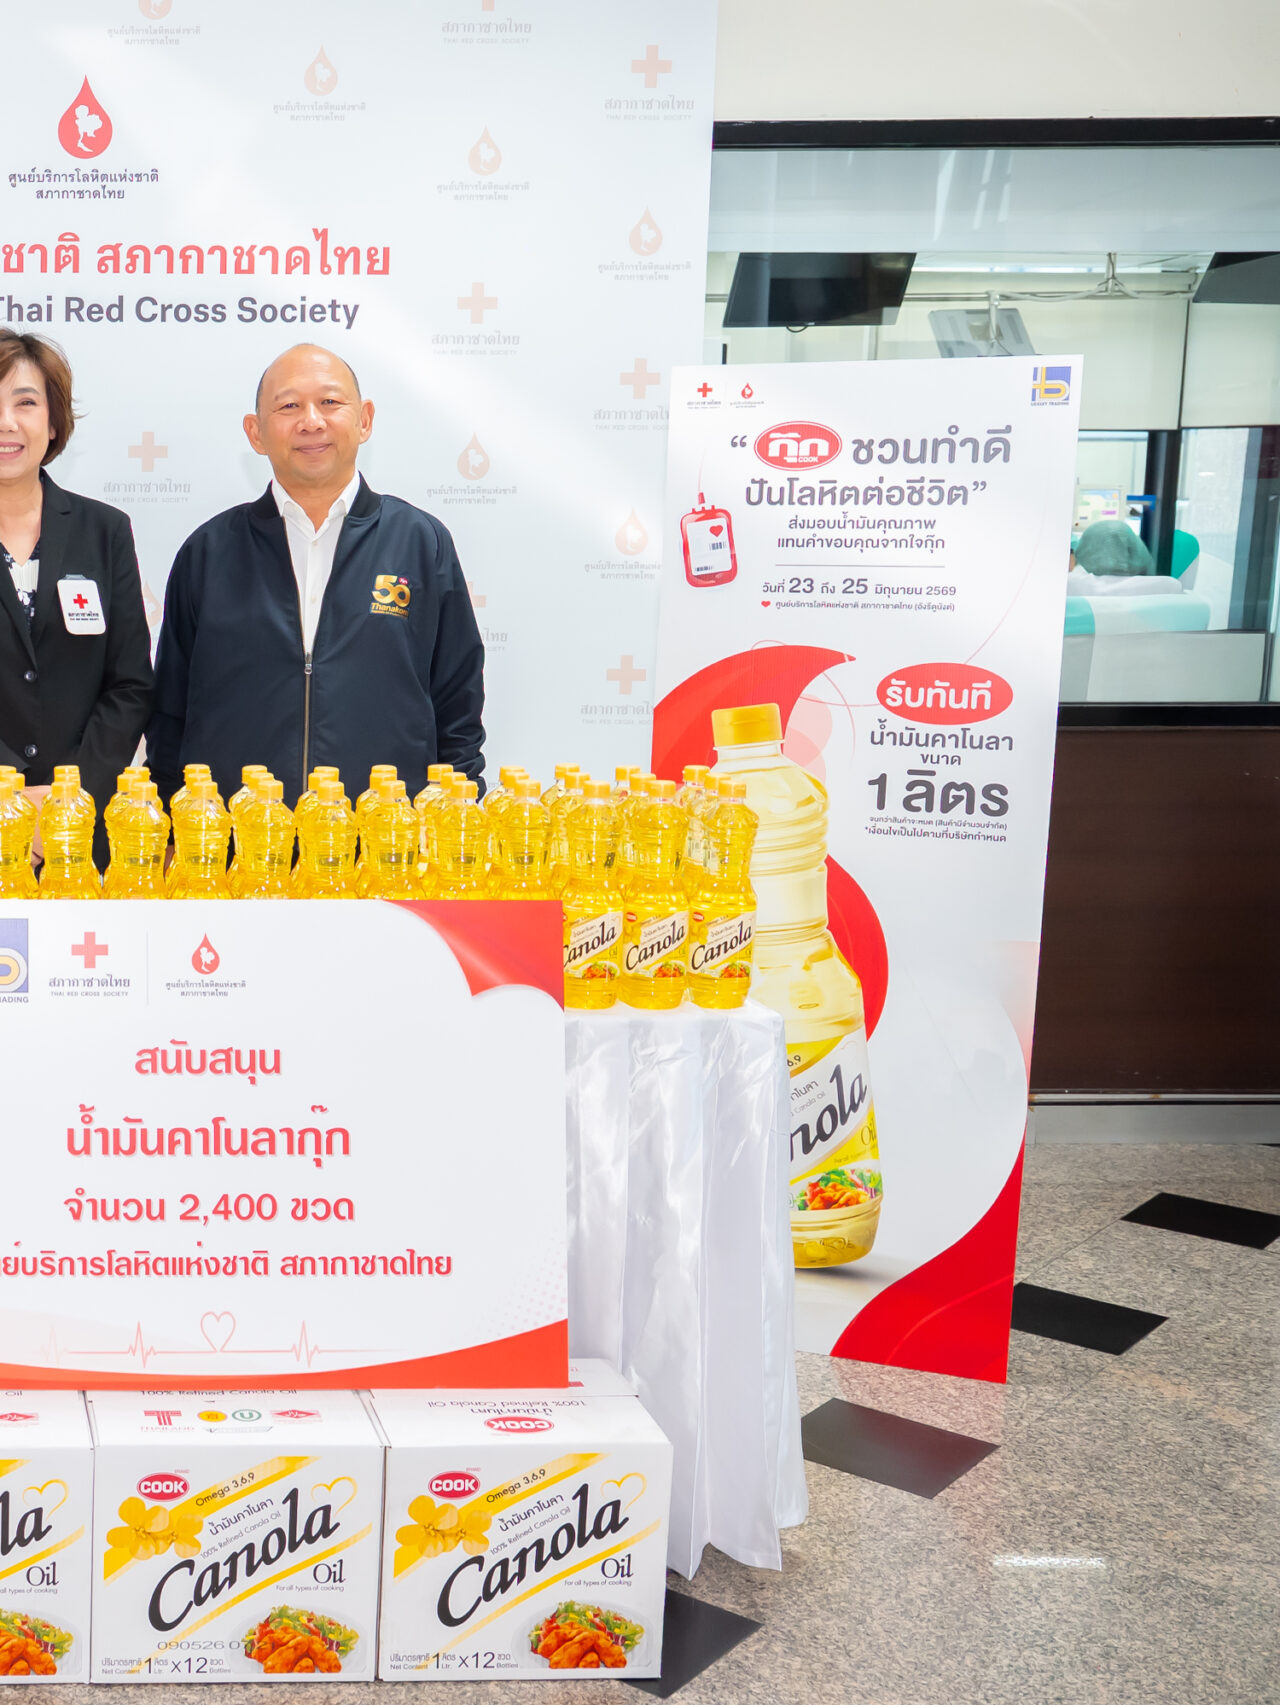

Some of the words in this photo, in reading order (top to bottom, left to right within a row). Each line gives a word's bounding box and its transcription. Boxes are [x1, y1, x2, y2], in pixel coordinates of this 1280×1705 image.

[8, 167, 159, 188] ศูนย์บริการโลหิตแห่งชาติ
[36, 184, 125, 200] สภากาชาดไทย
[96, 227, 392, 277] สภากาชาดไทย
[65, 295, 124, 323] Red
[135, 296, 227, 323] Cross
[237, 296, 360, 331] Society
[768, 432, 830, 464] กุ๊ก
[852, 424, 1013, 465] ชวนทำดี
[798, 456, 819, 464] COOK
[788, 511, 936, 535] ส่งมอบน้ำมันคุณภาพ
[777, 534, 945, 554] แทนคำขอบคุณจากใจกุ๊ก
[762, 579, 785, 593] วันที่
[789, 577, 814, 593] 23
[821, 582, 836, 594] ถึง
[841, 578, 868, 594] 25
[874, 583, 923, 598] มิถุนายน
[926, 586, 956, 596] 2569
[885, 678, 992, 711] รับทันที
[869, 718, 1014, 751] น้ำมันคาโนลา
[920, 752, 961, 766] ขนาด
[868, 773, 887, 811] 1
[902, 769, 1009, 818] ลิตร
[626, 920, 686, 971] Canola
[692, 920, 752, 971] Canola
[48, 973, 130, 987] สภากาชาดไทย
[165, 980, 246, 991] ศูนย์บริการโลหิตแห่งชาติ
[180, 988, 228, 997] สภากาชาดไทย
[135, 1039, 281, 1086] สนับสนุน
[790, 1064, 867, 1162] nola
[66, 1104, 351, 1169] น้ำมันคาโนลากุ๊ก
[64, 1187, 166, 1222] จำนวน
[179, 1193, 278, 1226] 2,400
[291, 1196, 355, 1222] ขวด
[280, 1249, 452, 1276] สภากาชาดไทย
[140, 1481, 185, 1493] COOK
[195, 1485, 230, 1507] Omega
[231, 1472, 255, 1489] 3,6,9
[431, 1479, 476, 1491] COOK
[486, 1482, 521, 1504] Omega
[522, 1468, 546, 1485] 3,6,9
[209, 1497, 274, 1537] น้ำมันคาโนลา
[499, 1494, 564, 1533] น้ำมันคาโนลา
[148, 1488, 340, 1632] Canola
[437, 1483, 629, 1628] Canola
[601, 1554, 634, 1578] Oil
[26, 1562, 59, 1586] Oil
[313, 1559, 346, 1583] Oil
[157, 1640, 225, 1650] 090526
[144, 1658, 152, 1674] 1
[432, 1653, 440, 1668] 1
